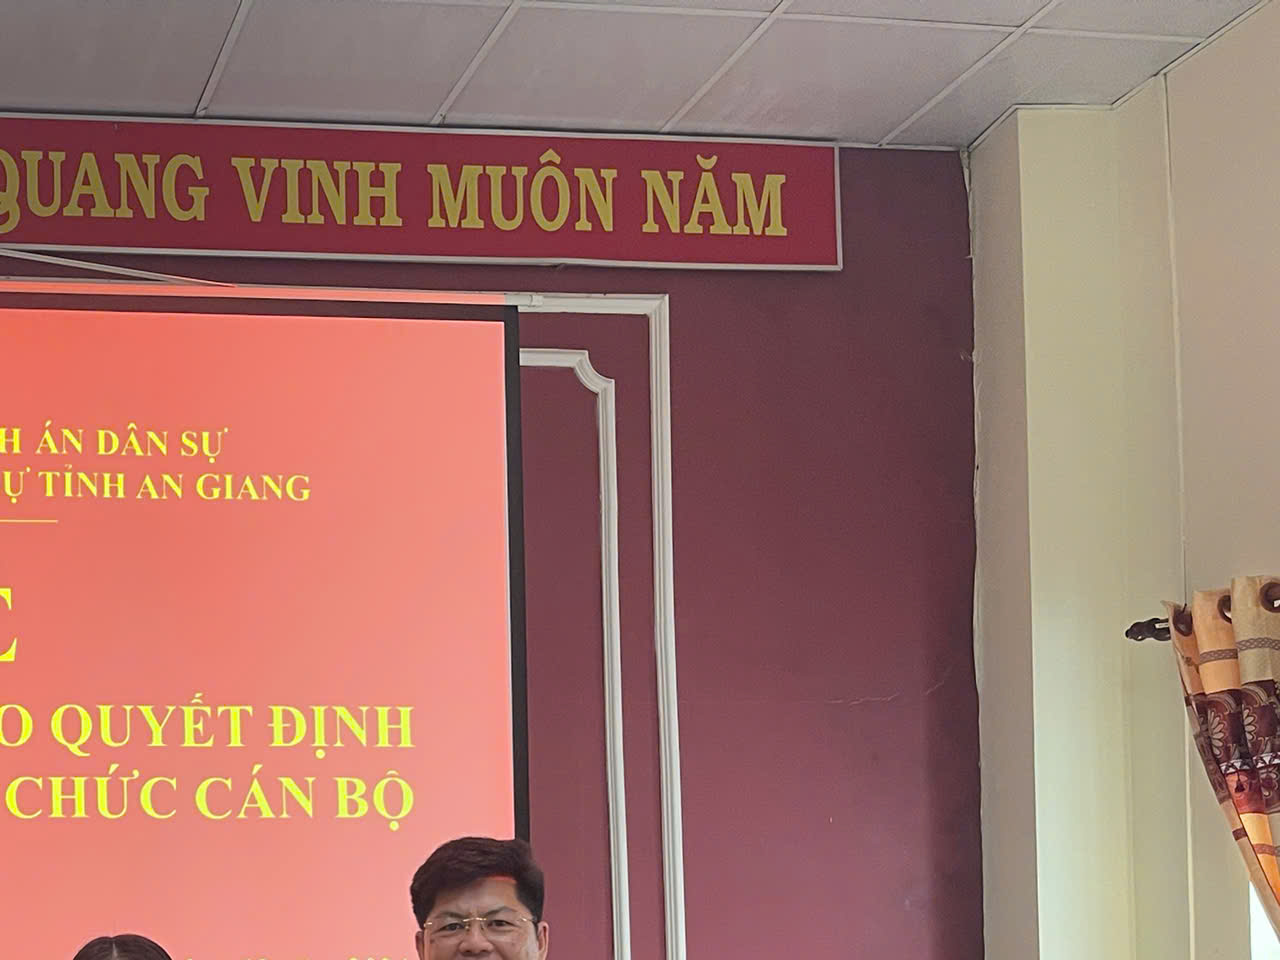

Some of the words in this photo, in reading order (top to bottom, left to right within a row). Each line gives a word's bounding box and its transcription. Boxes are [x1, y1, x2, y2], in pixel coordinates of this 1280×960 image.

[231, 156, 403, 228] VINH
[427, 147, 618, 233] MUÔN
[642, 154, 788, 236] NĂM
[35, 420, 83, 455] ÁN
[97, 422, 168, 457] DÂN
[180, 428, 229, 463] SỰ
[38, 464, 126, 499] TỈNH
[136, 473, 184, 500] AN
[195, 473, 311, 501] GIANG
[50, 692, 253, 758] QUYẾT
[268, 705, 415, 760] ĐỊNH
[4, 763, 177, 820] CHỨC
[194, 763, 317, 820] CÁN
[334, 769, 415, 832] BỘ
